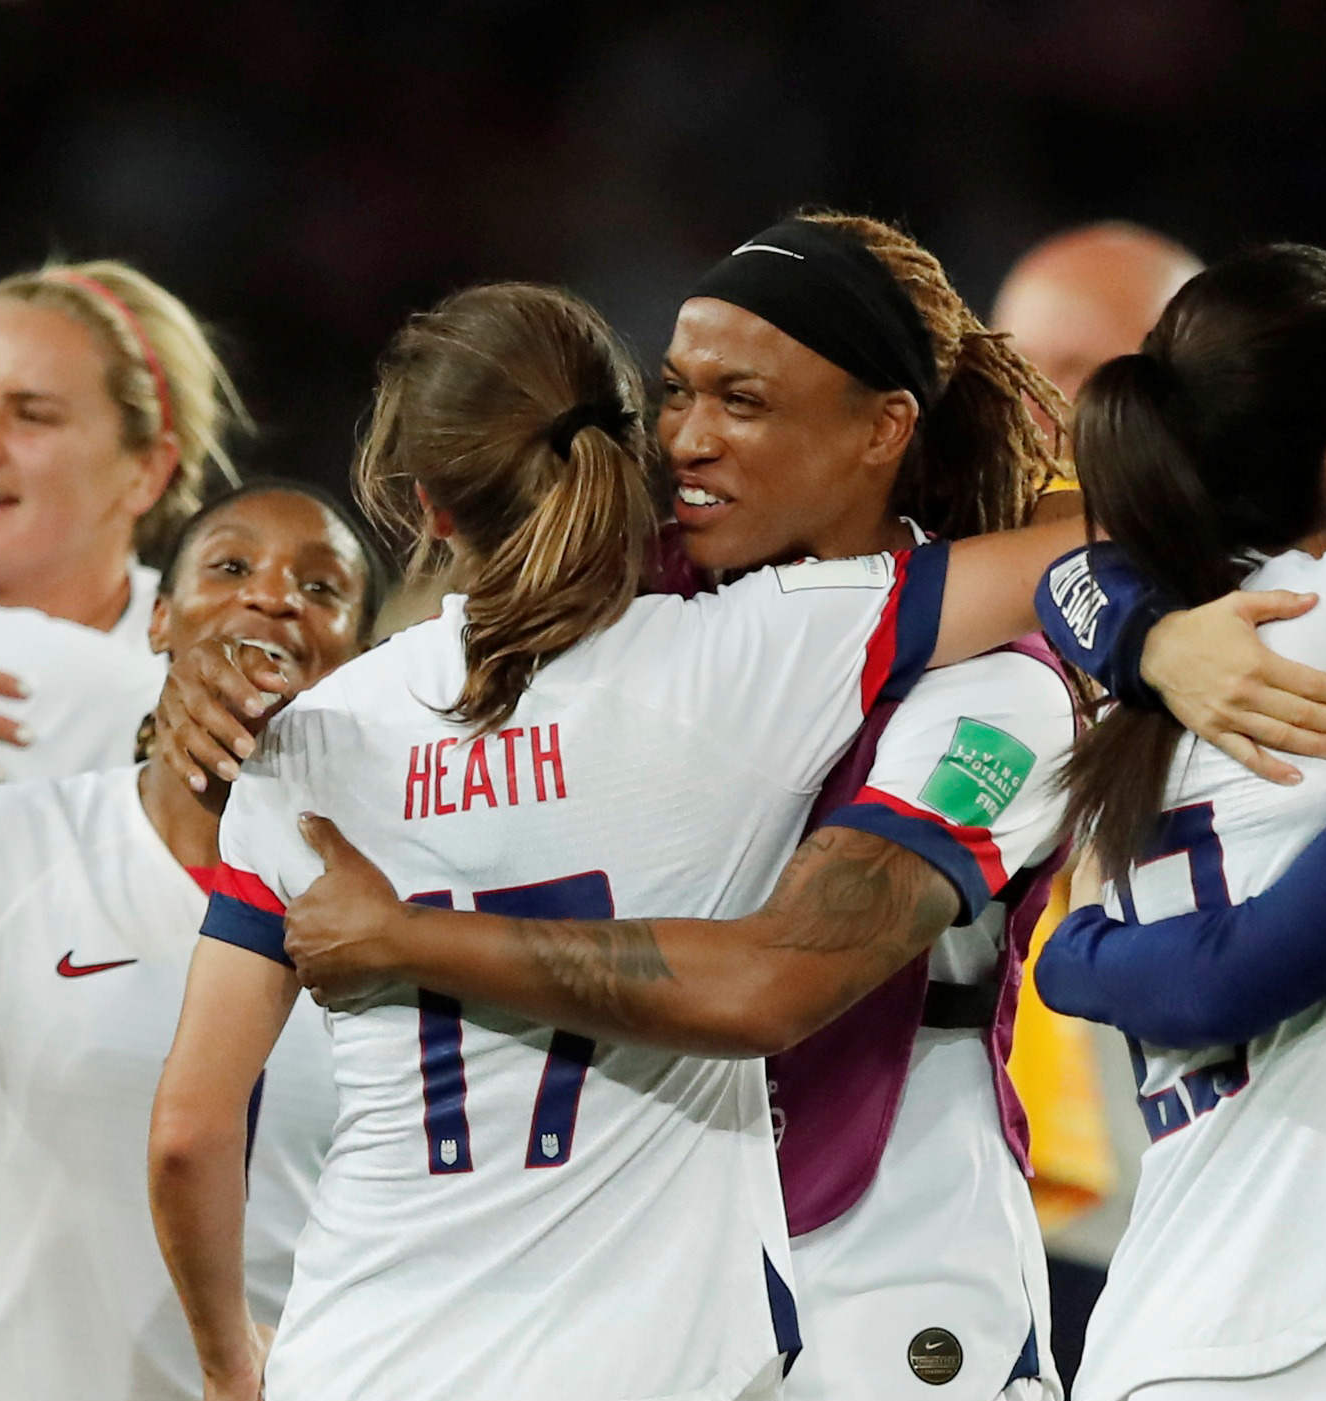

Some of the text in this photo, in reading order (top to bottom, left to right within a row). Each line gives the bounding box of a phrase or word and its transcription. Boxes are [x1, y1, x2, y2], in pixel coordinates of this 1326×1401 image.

[404, 723, 566, 820] HEATH
[953, 744, 1020, 788] LIVING
[404, 869, 615, 1175] 17
